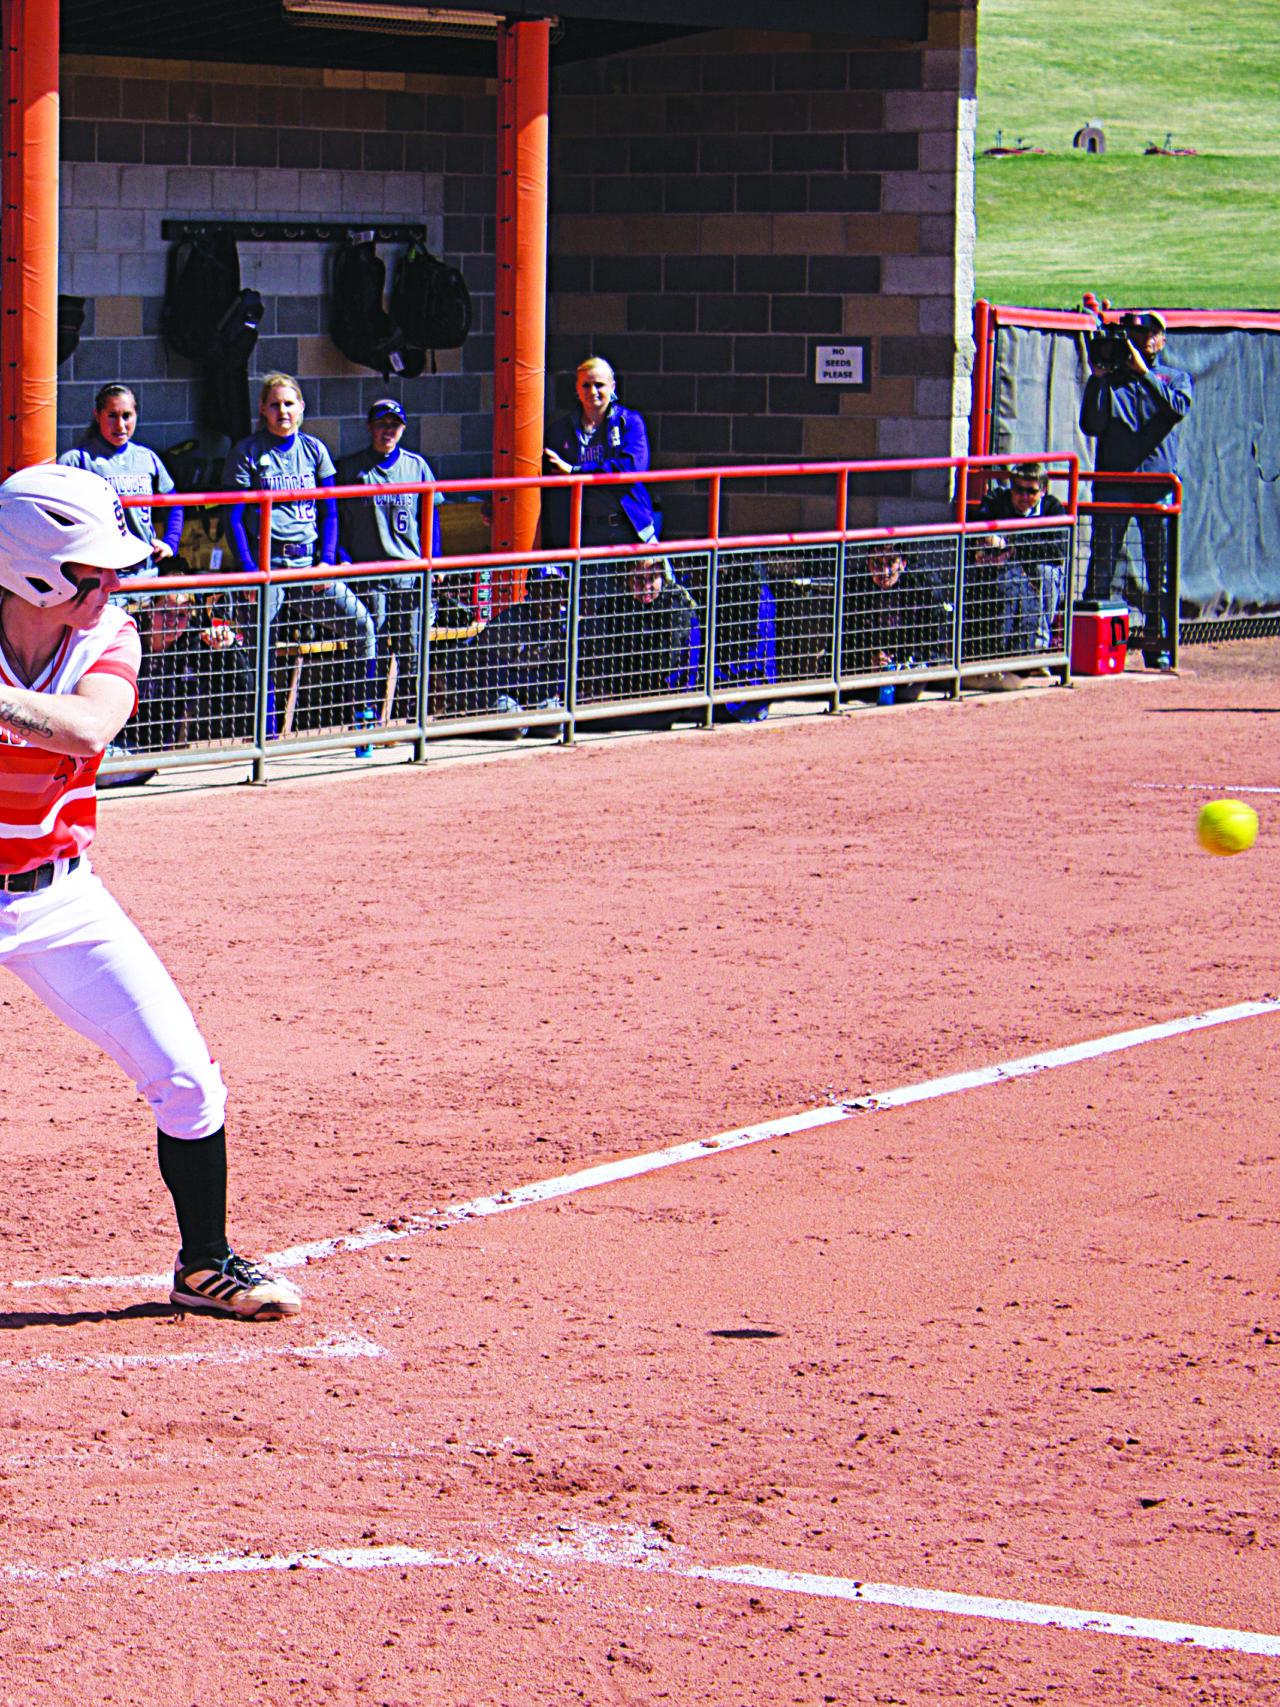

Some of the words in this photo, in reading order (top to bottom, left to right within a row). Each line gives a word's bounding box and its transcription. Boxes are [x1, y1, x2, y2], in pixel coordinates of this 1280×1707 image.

[825, 359, 852, 367] SEEDS
[823, 371, 853, 379] PLEASE
[396, 510, 408, 533] 6
